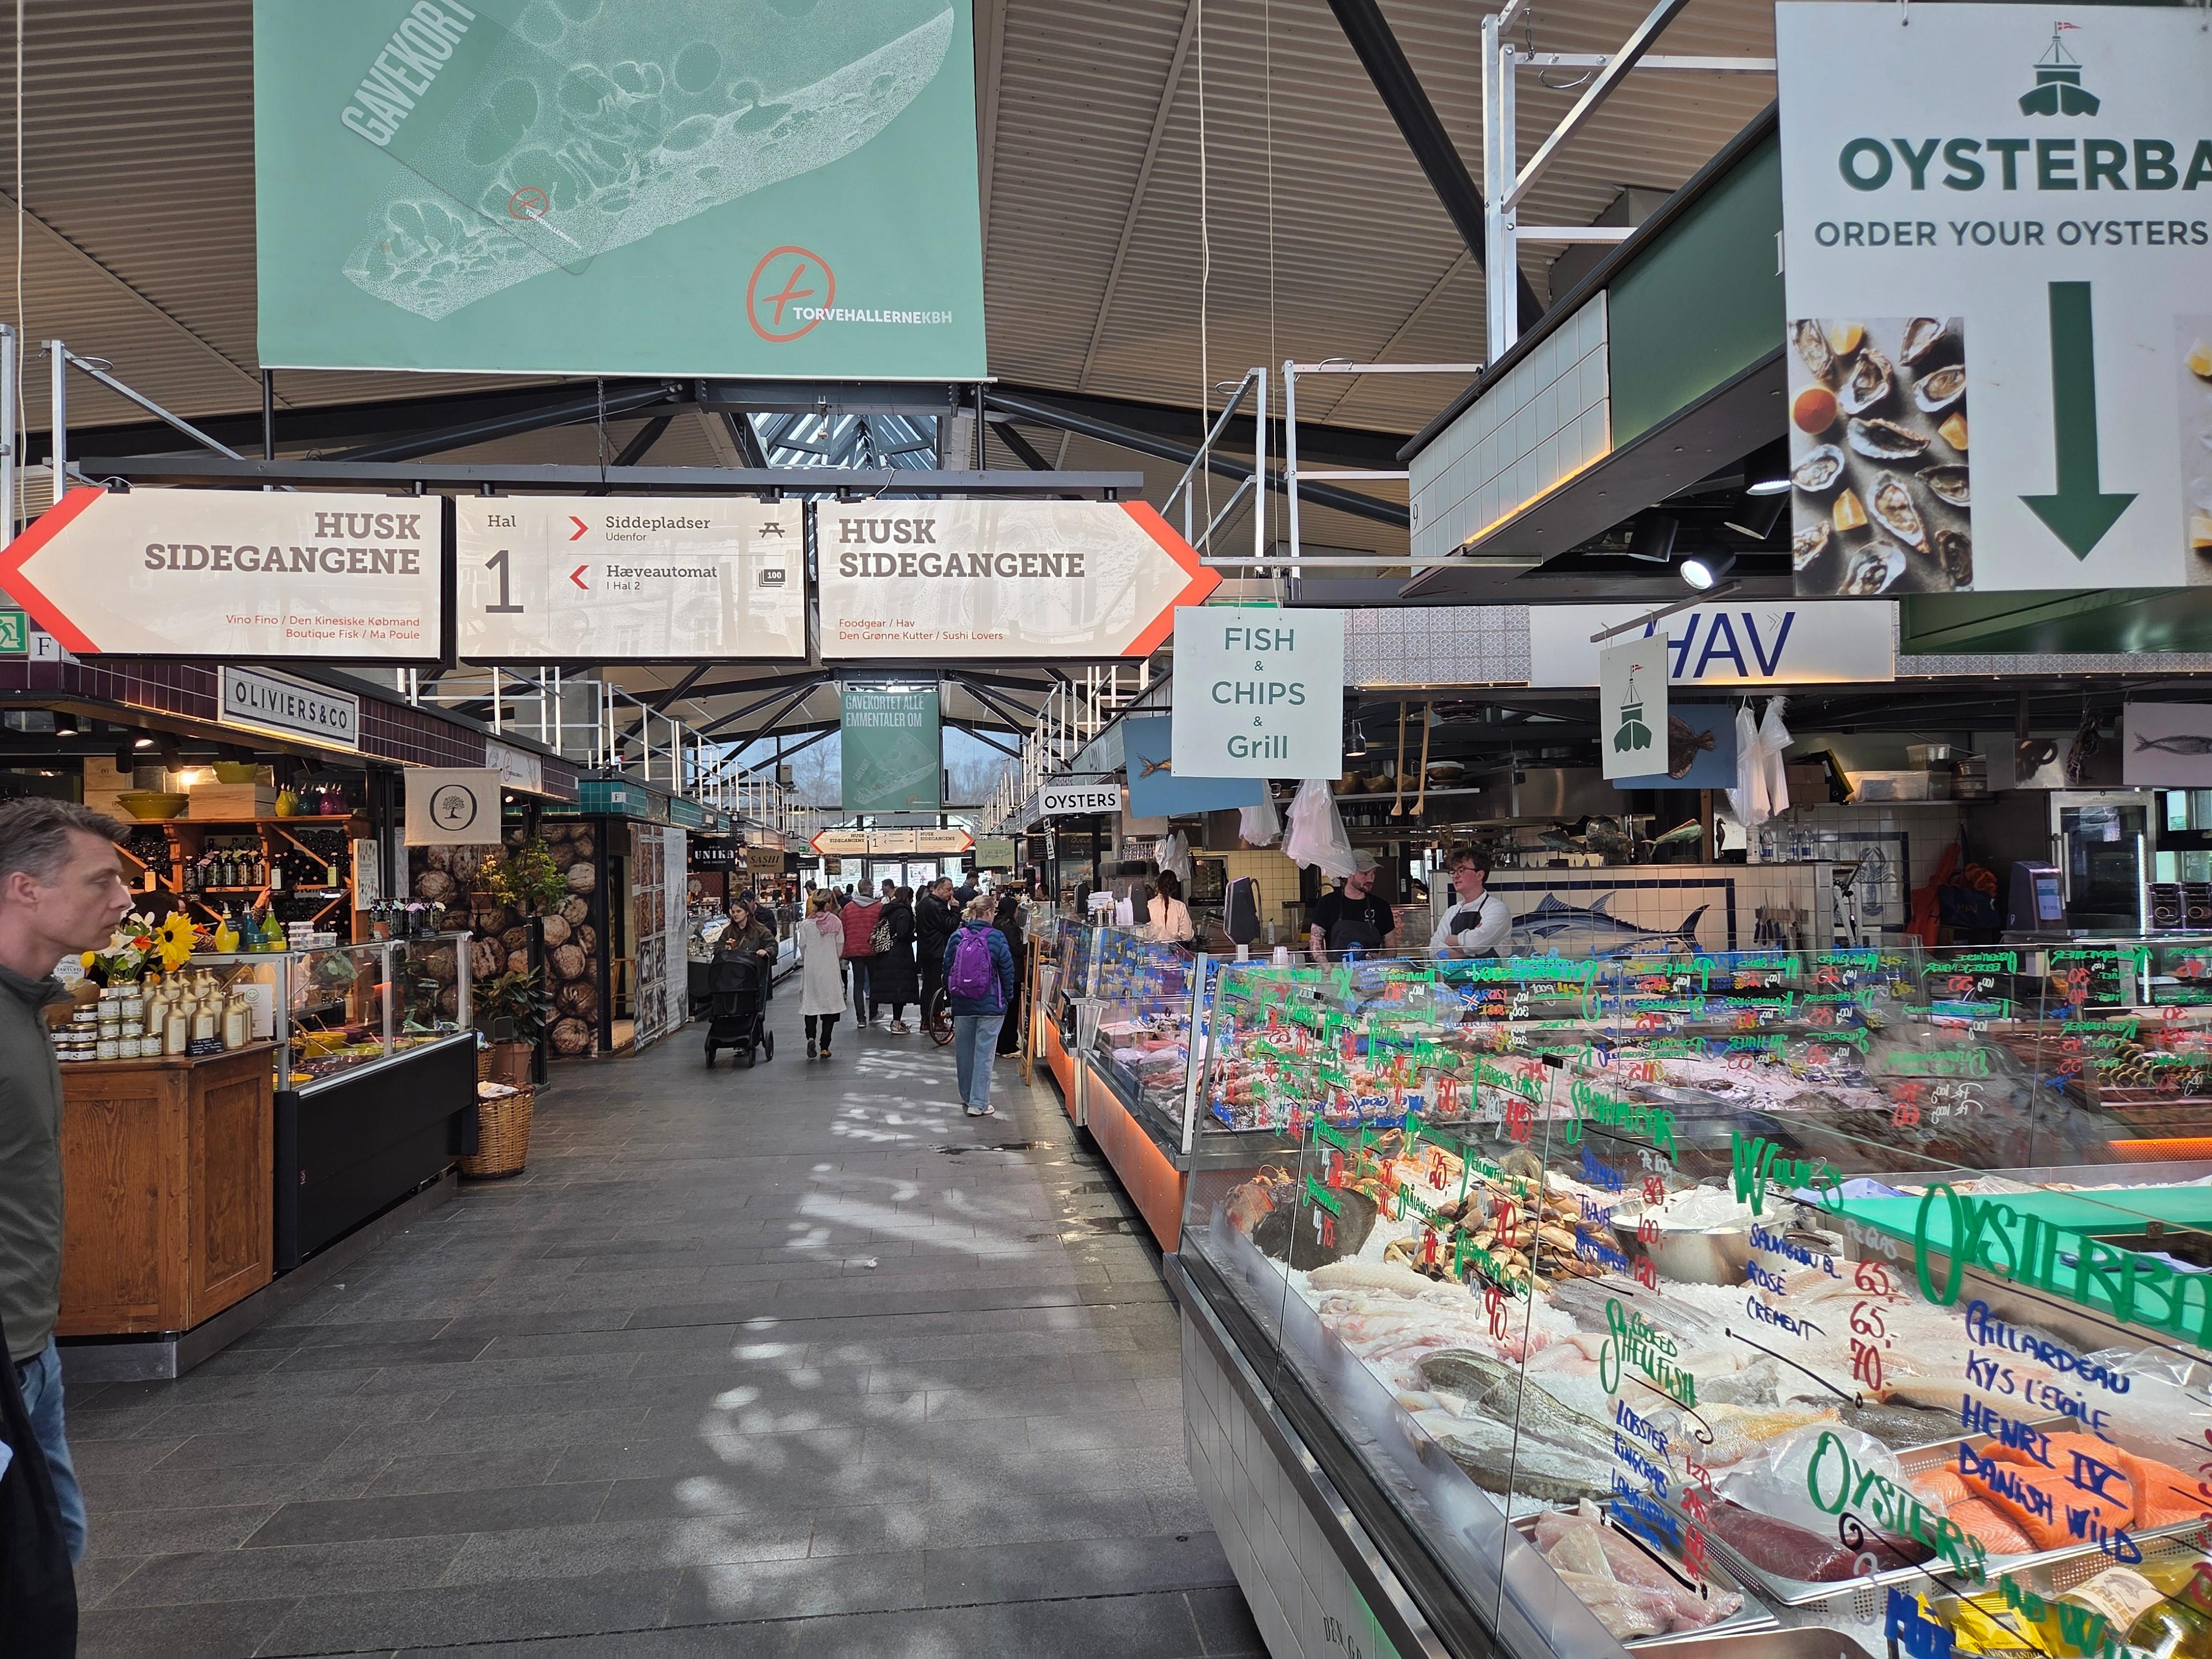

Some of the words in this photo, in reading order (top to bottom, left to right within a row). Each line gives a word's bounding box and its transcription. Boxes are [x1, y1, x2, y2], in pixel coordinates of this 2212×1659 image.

[1814, 221, 1937, 247] ORDER
[1949, 221, 2045, 247] YOUR
[2057, 220, 2209, 246] OYSTERS
[792, 306, 952, 324] TORVEHALLERNEKBH
[315, 512, 420, 540] HUSK
[488, 515, 517, 528] Hal
[605, 516, 711, 529] Siddepladser
[606, 532, 647, 541] Udenfor
[839, 519, 936, 544] HUSK
[144, 544, 420, 574] SIDEGANGENE
[838, 553, 1085, 577] SIDEGANGENE
[607, 565, 717, 578] Hæveautomat
[767, 571, 782, 580] 100
[484, 550, 524, 614] 1
[613, 581, 632, 590] Hal
[634, 582, 640, 590] 2
[226, 615, 251, 625] Vino
[254, 615, 278, 625] Fino
[290, 617, 311, 626] Den
[314, 616, 361, 627] Kinesiske
[368, 617, 420, 627] Købmand
[839, 618, 886, 630] Foodgear
[896, 619, 915, 628] Hav
[286, 629, 335, 641] Boutique
[338, 630, 358, 639] Fisk
[369, 630, 386, 640] Ma
[389, 630, 420, 640] Poule
[839, 632, 859, 640] Den
[863, 631, 900, 641] Grønne
[902, 631, 933, 641] Kutter
[942, 631, 968, 641] Sushi
[971, 632, 1003, 641] Lovers
[1224, 628, 1295, 651] FISH
[37, 637, 52, 656] F
[1254, 660, 1264, 671] &
[845, 695, 901, 711] GAVEKORTET
[903, 695, 924, 710] ALLE
[1211, 681, 1306, 707] CHIPS
[236, 681, 348, 730] OLIVIERS&CO
[846, 713, 906, 727] EMMENTALER
[907, 713, 922, 727] OM
[1253, 716, 1263, 727] &
[1227, 734, 1288, 759] Grill
[1044, 792, 1116, 809] OYSTERS
[695, 850, 734, 859] UNIKA
[1576, 1193, 1611, 1230] TUNA
[1966, 1349, 2015, 1395] KYS
[1616, 1399, 1672, 1469] LOBSTER
[1961, 1393, 2056, 1469] HENRI
[1959, 1442, 2054, 1526] DANISH
